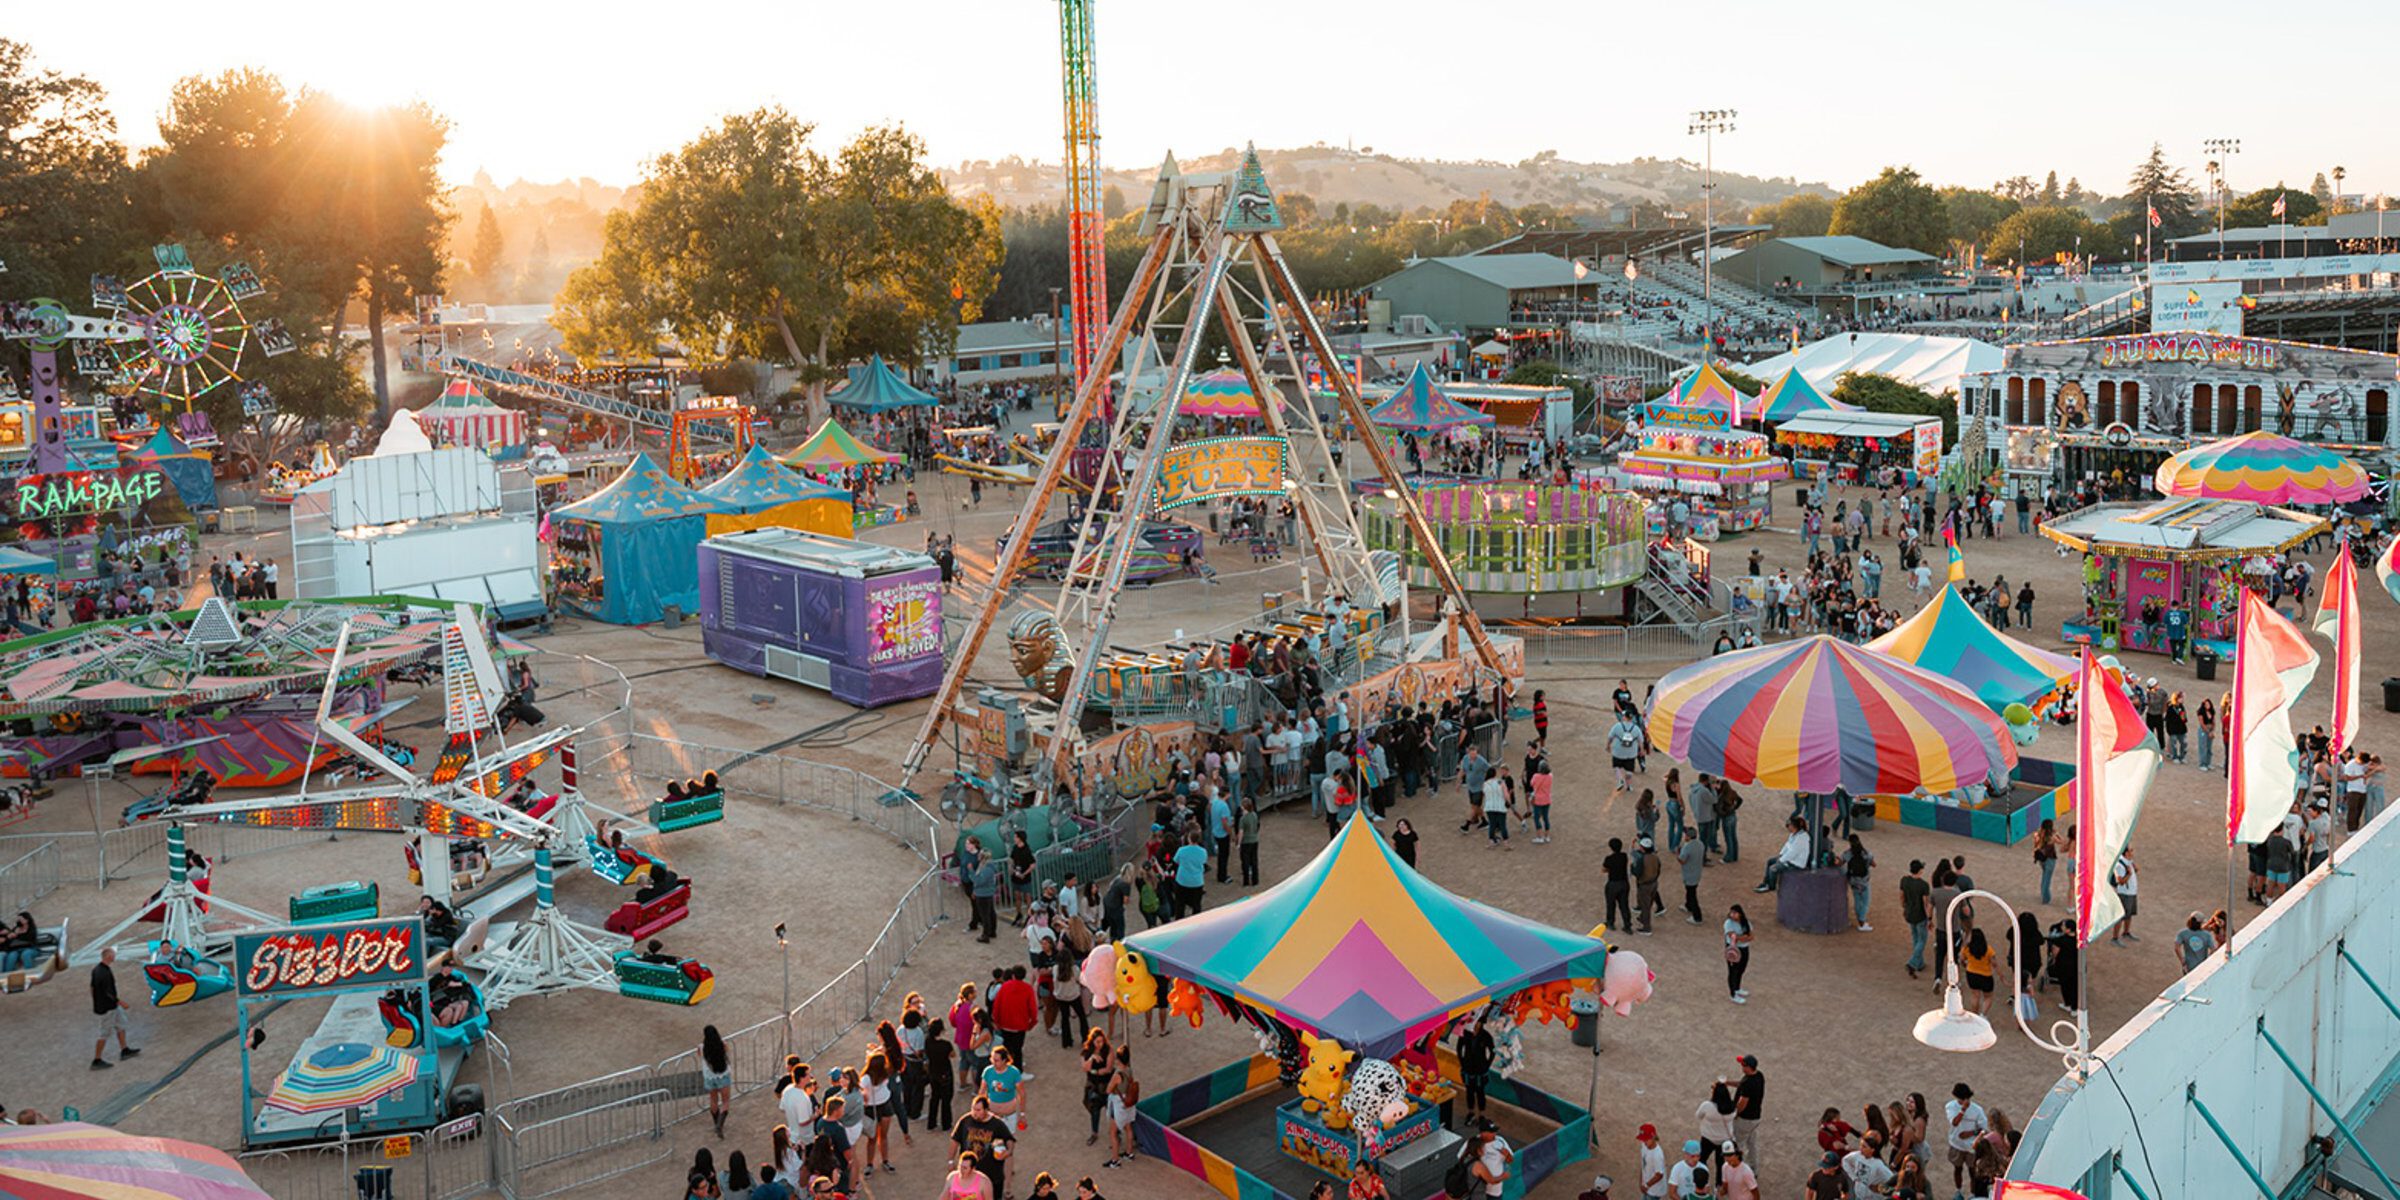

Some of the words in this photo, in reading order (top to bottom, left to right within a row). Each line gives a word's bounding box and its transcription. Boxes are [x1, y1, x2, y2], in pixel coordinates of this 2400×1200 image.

[2158, 312, 2182, 321] LIGHT
[2190, 310, 2208, 319] BEER
[2102, 337, 2276, 368] JUMANJI
[18, 472, 162, 516] RAMPAGE
[1163, 460, 1279, 500] FURY
[246, 931, 413, 991] Sizzler
[450, 1119, 473, 1133] EXIT
